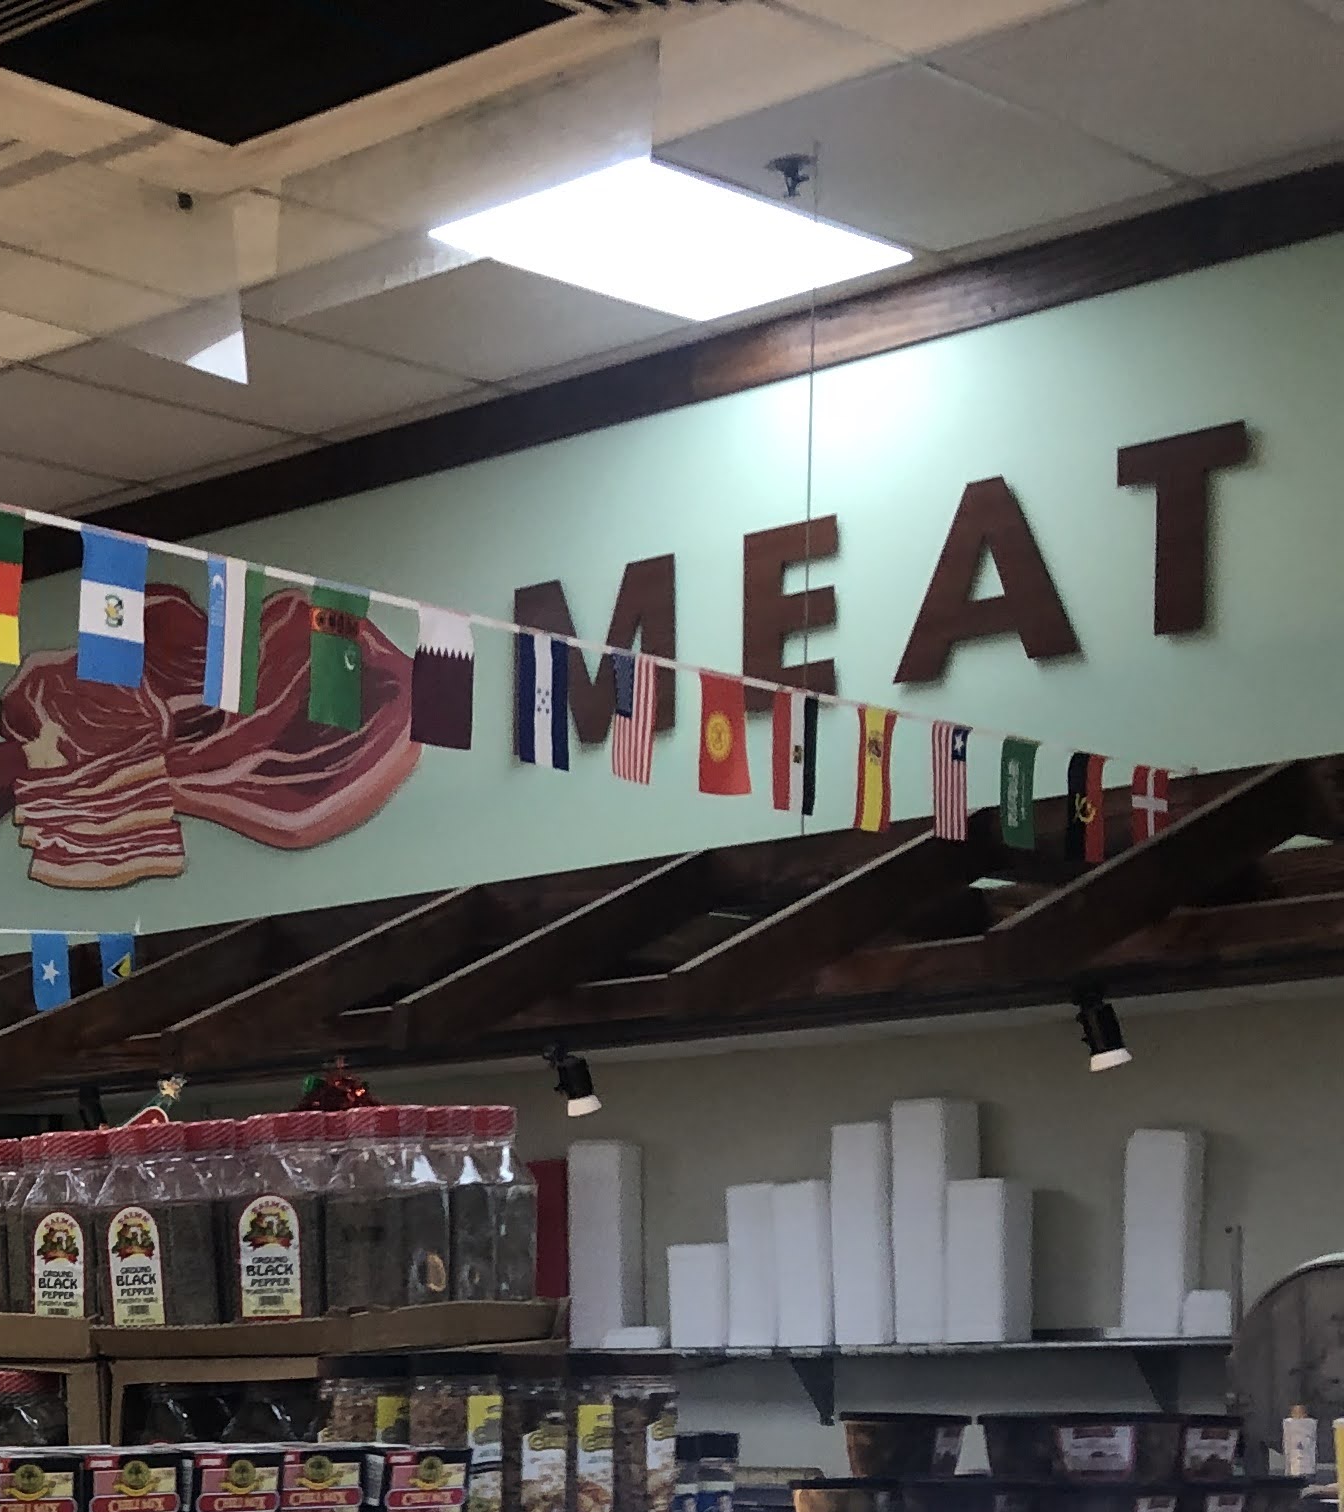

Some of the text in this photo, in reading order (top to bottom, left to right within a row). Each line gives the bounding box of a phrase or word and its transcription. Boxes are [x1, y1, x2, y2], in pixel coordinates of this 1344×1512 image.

[513, 420, 1246, 757] MEAT
[246, 1264, 294, 1276] BLACK
[39, 1277, 78, 1290] BLACK
[116, 1274, 157, 1286] BLACK
